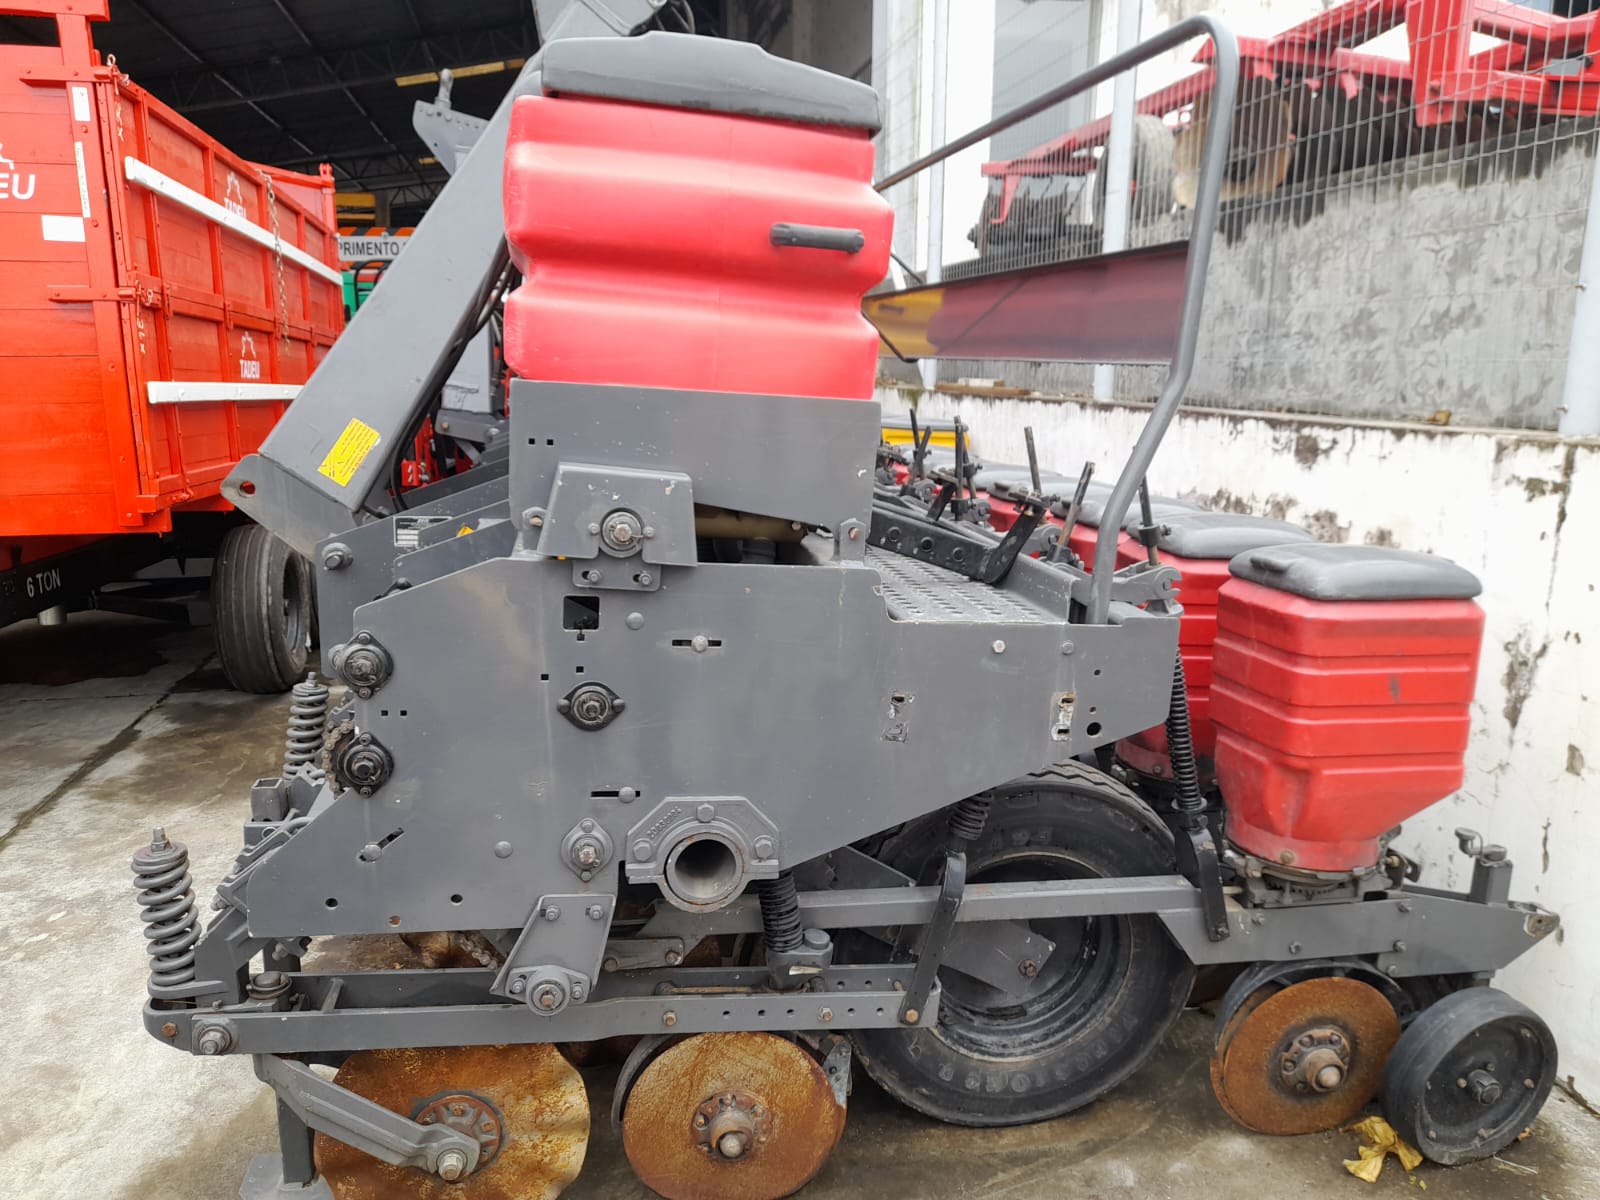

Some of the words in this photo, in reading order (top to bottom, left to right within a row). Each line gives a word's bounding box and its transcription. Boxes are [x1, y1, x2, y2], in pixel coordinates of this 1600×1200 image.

[239, 359, 260, 379] TADEU
[26, 576, 35, 598] 6
[36, 567, 61, 594] TON
